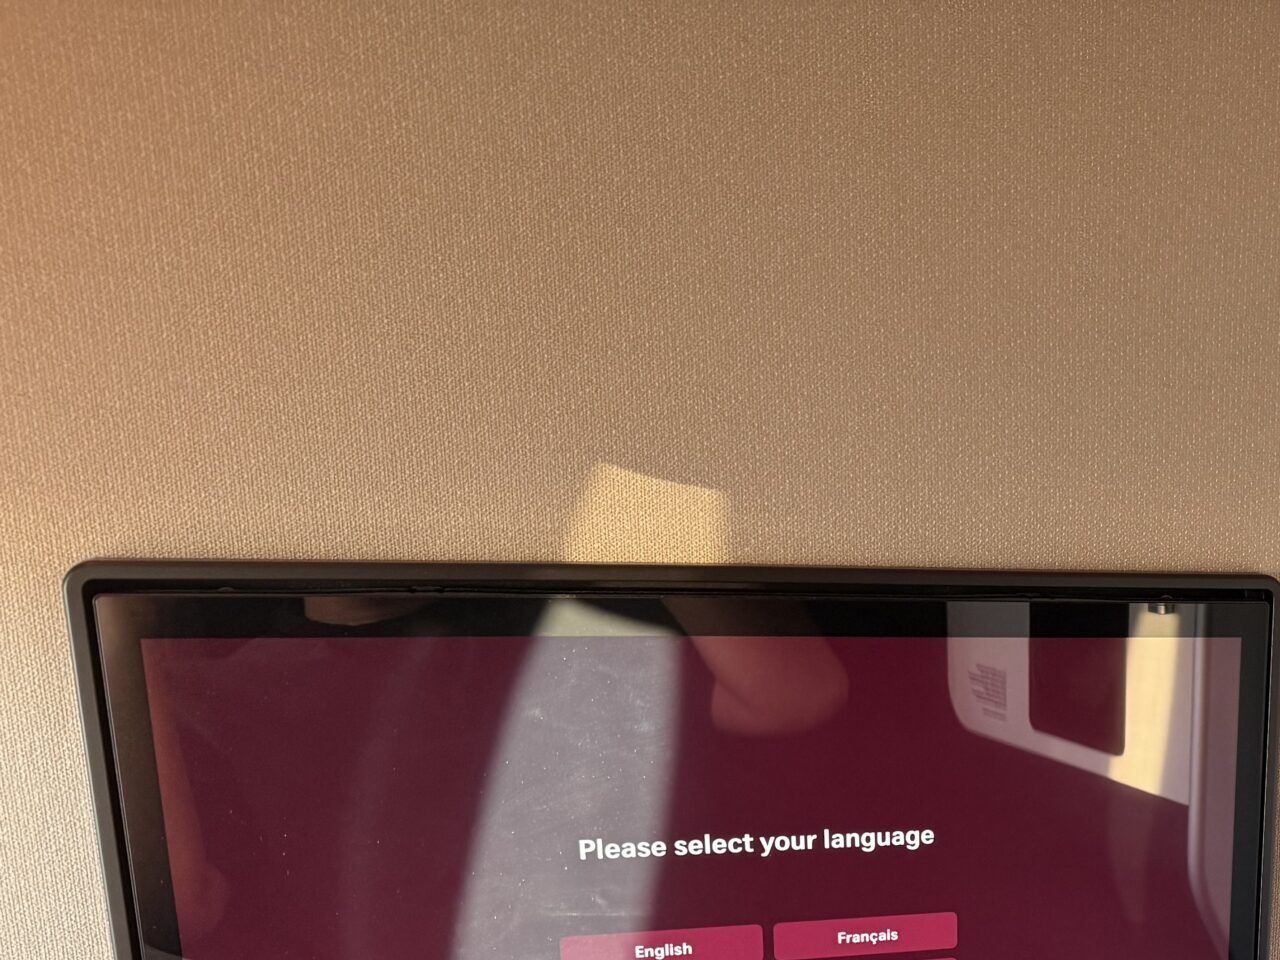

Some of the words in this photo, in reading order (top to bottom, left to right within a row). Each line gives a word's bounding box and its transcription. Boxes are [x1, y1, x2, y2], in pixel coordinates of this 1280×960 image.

[578, 838, 667, 861] Please
[674, 833, 755, 856] select
[759, 834, 818, 857] your
[823, 828, 935, 853] language
[837, 928, 899, 945] Français
[634, 942, 693, 960] English
